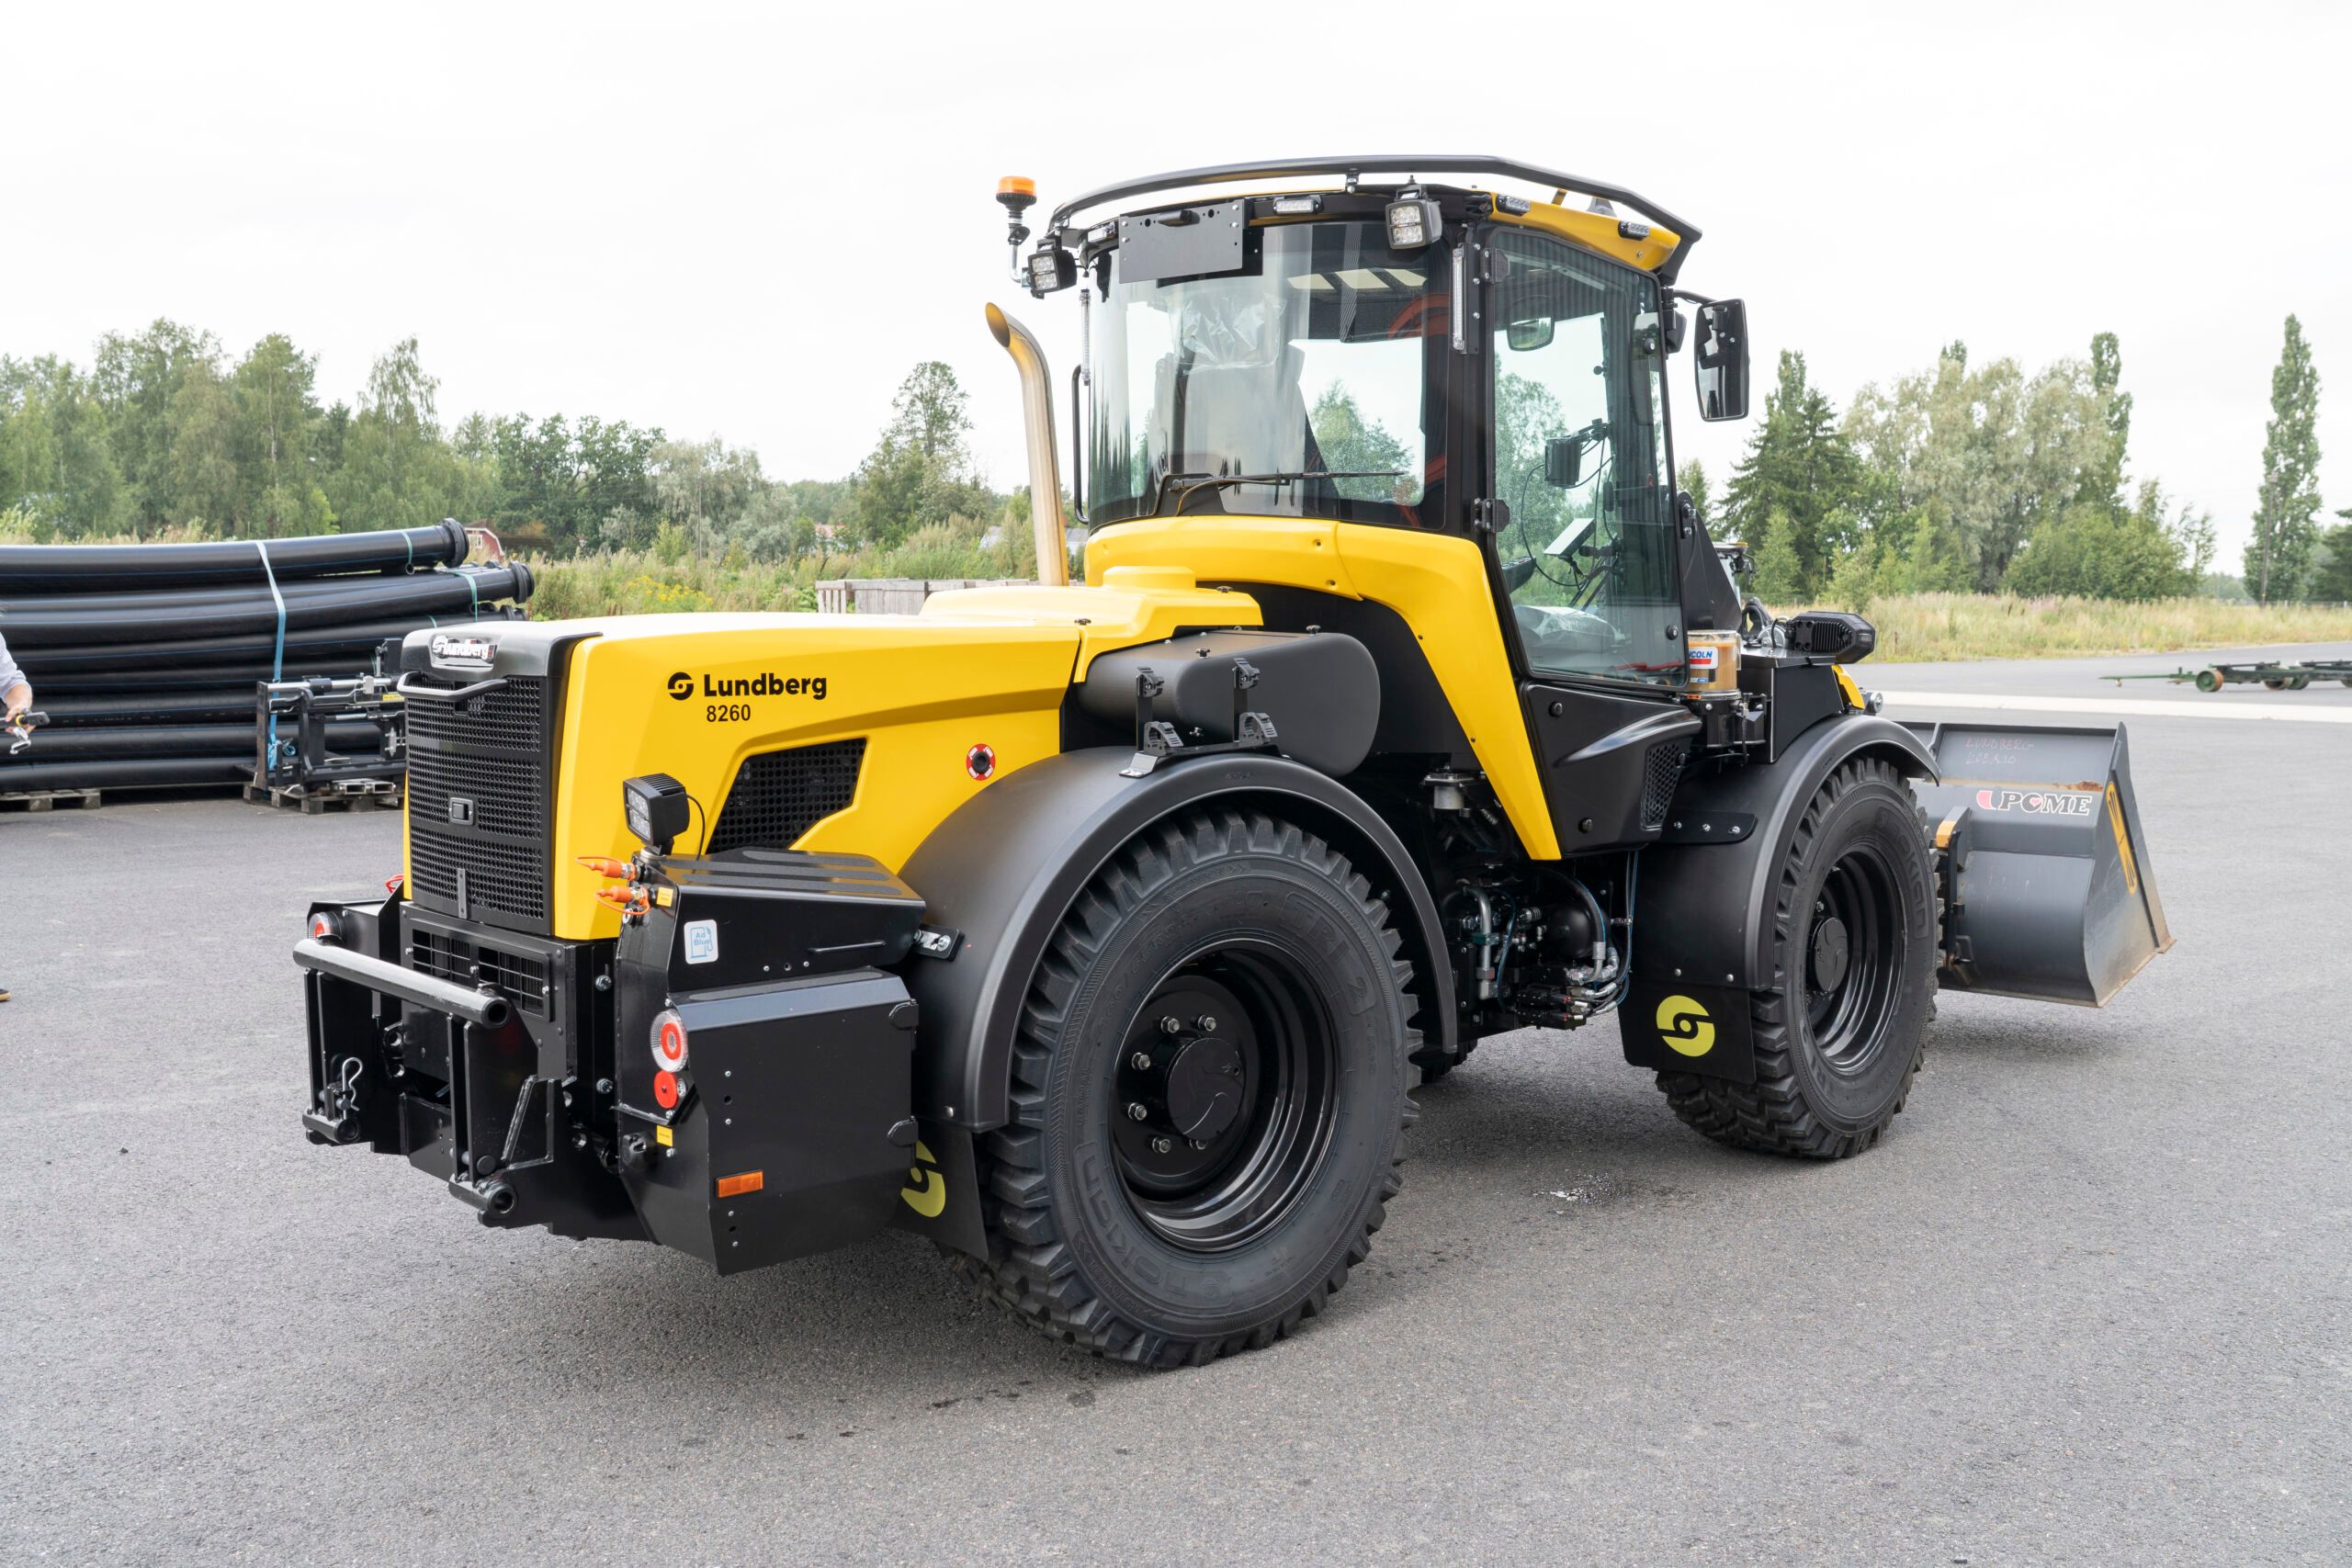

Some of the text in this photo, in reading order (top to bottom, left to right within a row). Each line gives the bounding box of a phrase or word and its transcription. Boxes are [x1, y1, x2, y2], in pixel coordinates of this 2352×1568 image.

[703, 672, 827, 701] Lundberg
[707, 704, 751, 723] 8260
[1998, 791, 2092, 816] POME
